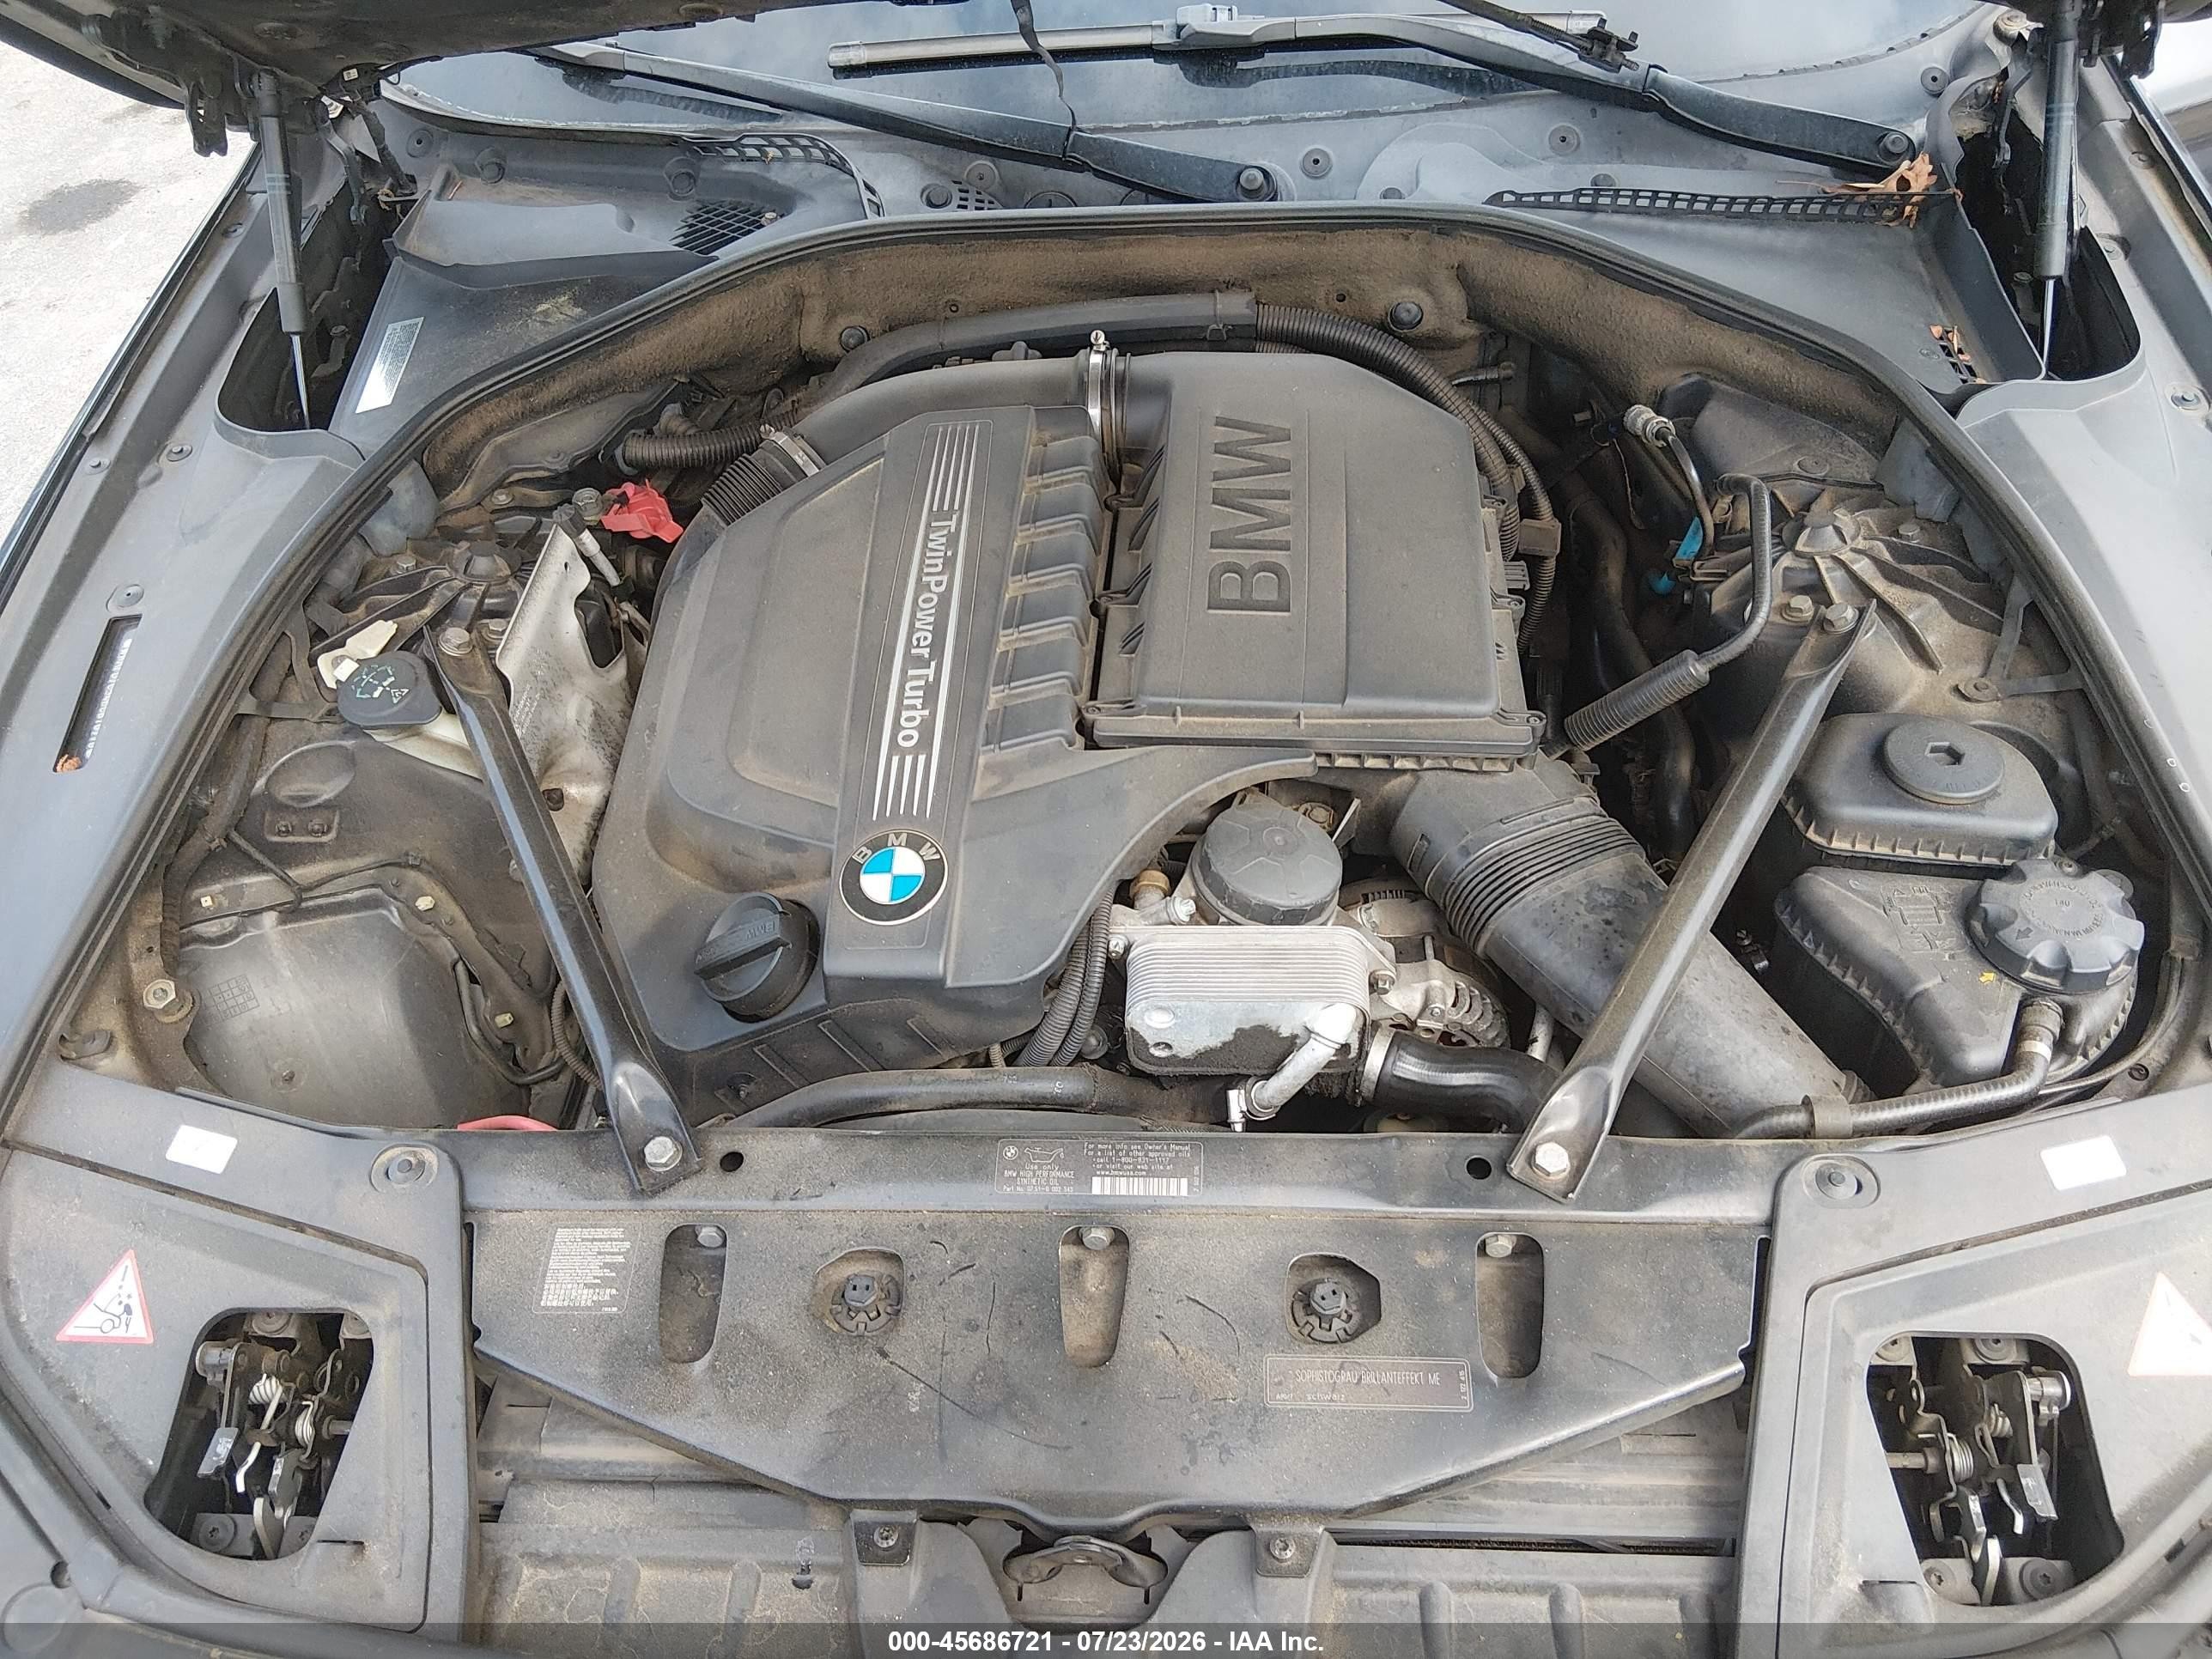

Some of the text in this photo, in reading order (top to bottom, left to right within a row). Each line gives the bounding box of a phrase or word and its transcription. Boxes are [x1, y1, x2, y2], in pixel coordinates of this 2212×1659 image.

[1207, 416, 1291, 613] BMW
[897, 512, 960, 748] TwinPower Turbo
[852, 832, 940, 864] BMW
[1042, 1163, 1060, 1171] only
[1295, 1369, 1441, 1385] SOPHISTOGRAU BRILLANTEFFEKT ME
[1305, 1392, 1345, 1401] schwarz
